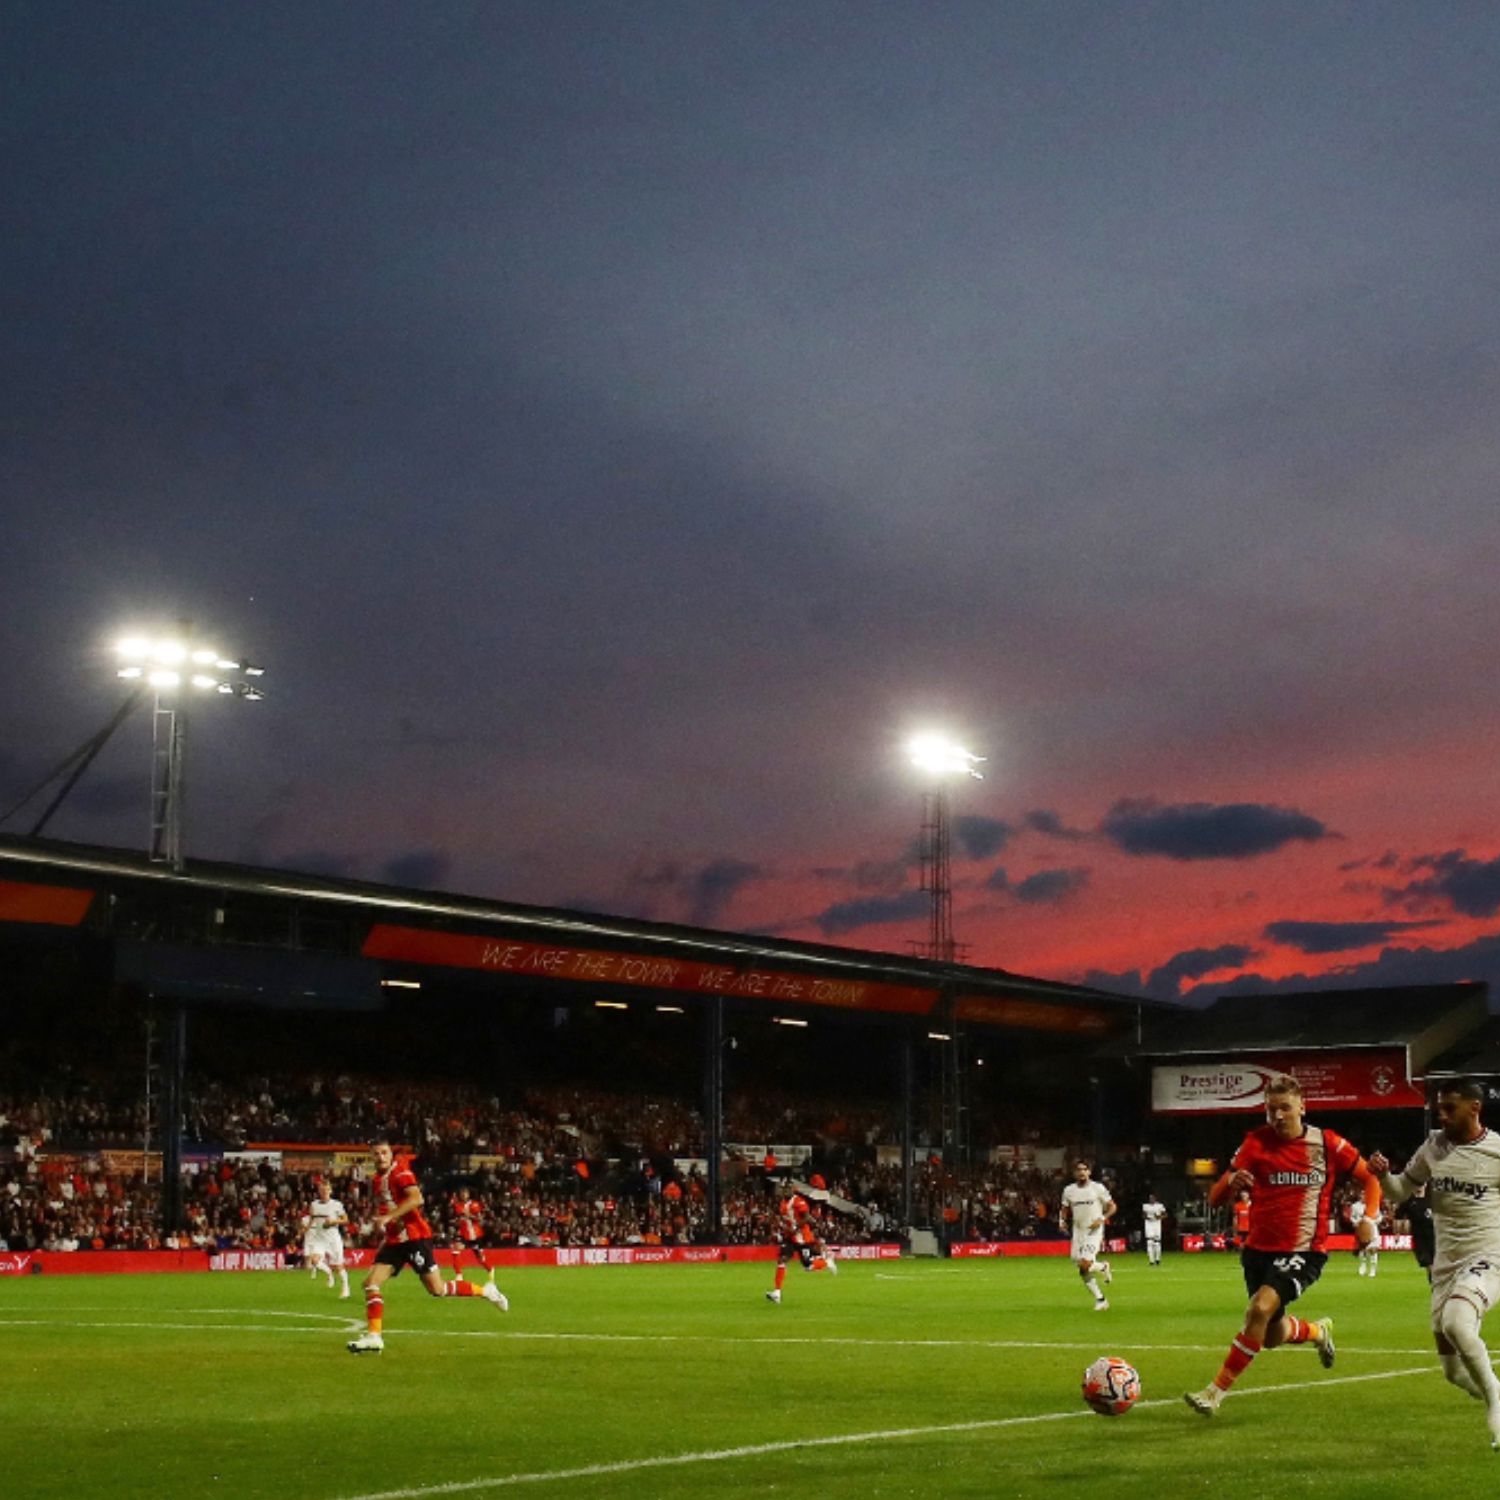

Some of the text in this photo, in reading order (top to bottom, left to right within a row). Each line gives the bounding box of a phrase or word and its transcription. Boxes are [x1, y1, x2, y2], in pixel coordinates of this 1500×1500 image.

[482, 944, 680, 984] WE ARE THE TOWN
[698, 970, 733, 989] WE
[729, 973, 771, 993] ARE
[770, 976, 804, 998] THE
[1180, 1073, 1243, 1089] Prestige
[1469, 1261, 1490, 1277] 2
